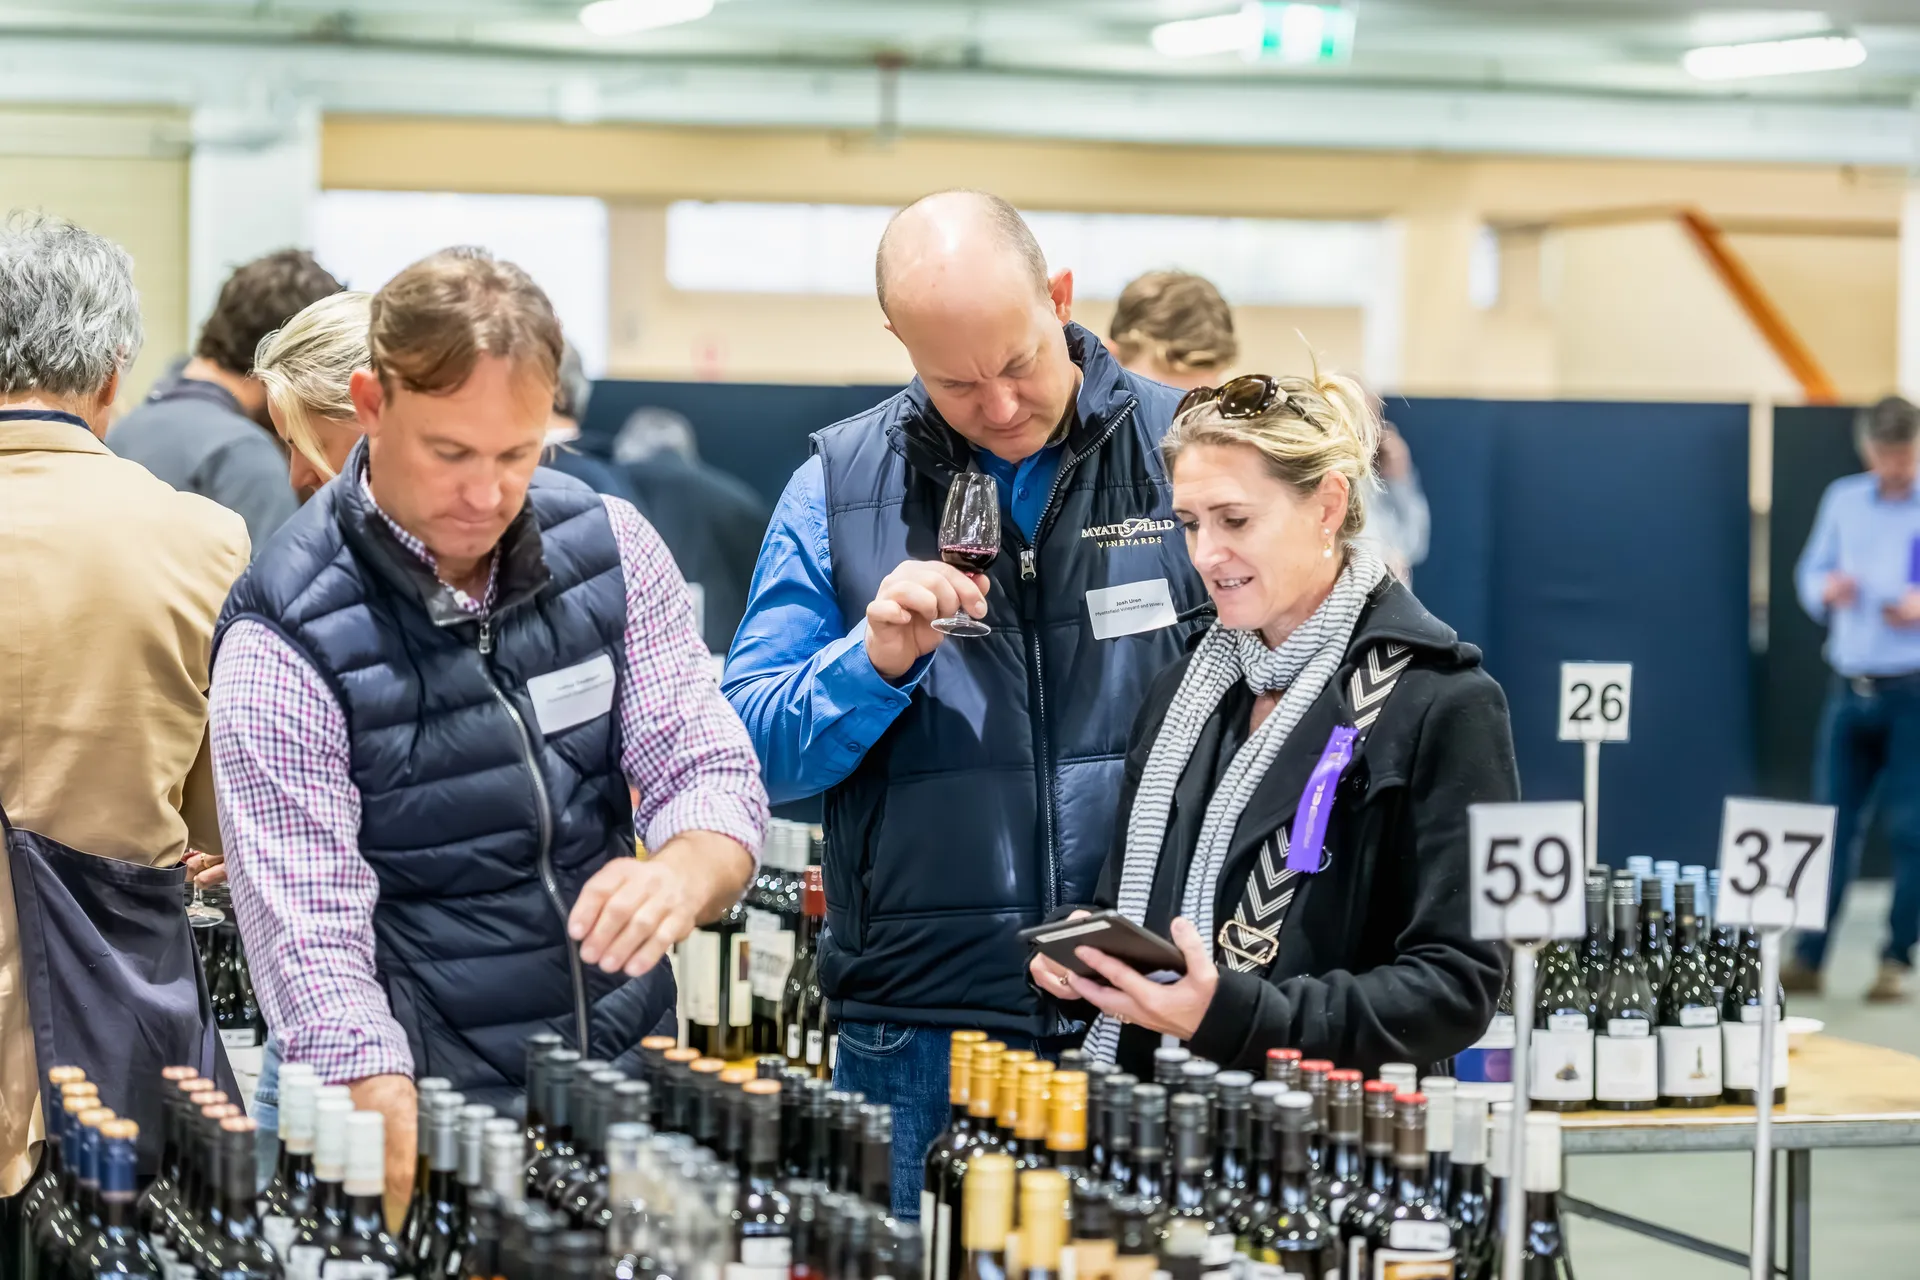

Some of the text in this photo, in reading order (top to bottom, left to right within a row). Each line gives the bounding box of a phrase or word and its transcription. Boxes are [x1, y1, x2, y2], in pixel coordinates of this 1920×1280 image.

[1081, 518, 1175, 537] MYATTSFIELD
[1098, 537, 1162, 548] VINEYARDS
[1569, 683, 1623, 721] 26
[1483, 836, 1572, 906] 59
[1729, 830, 1825, 899] 37
